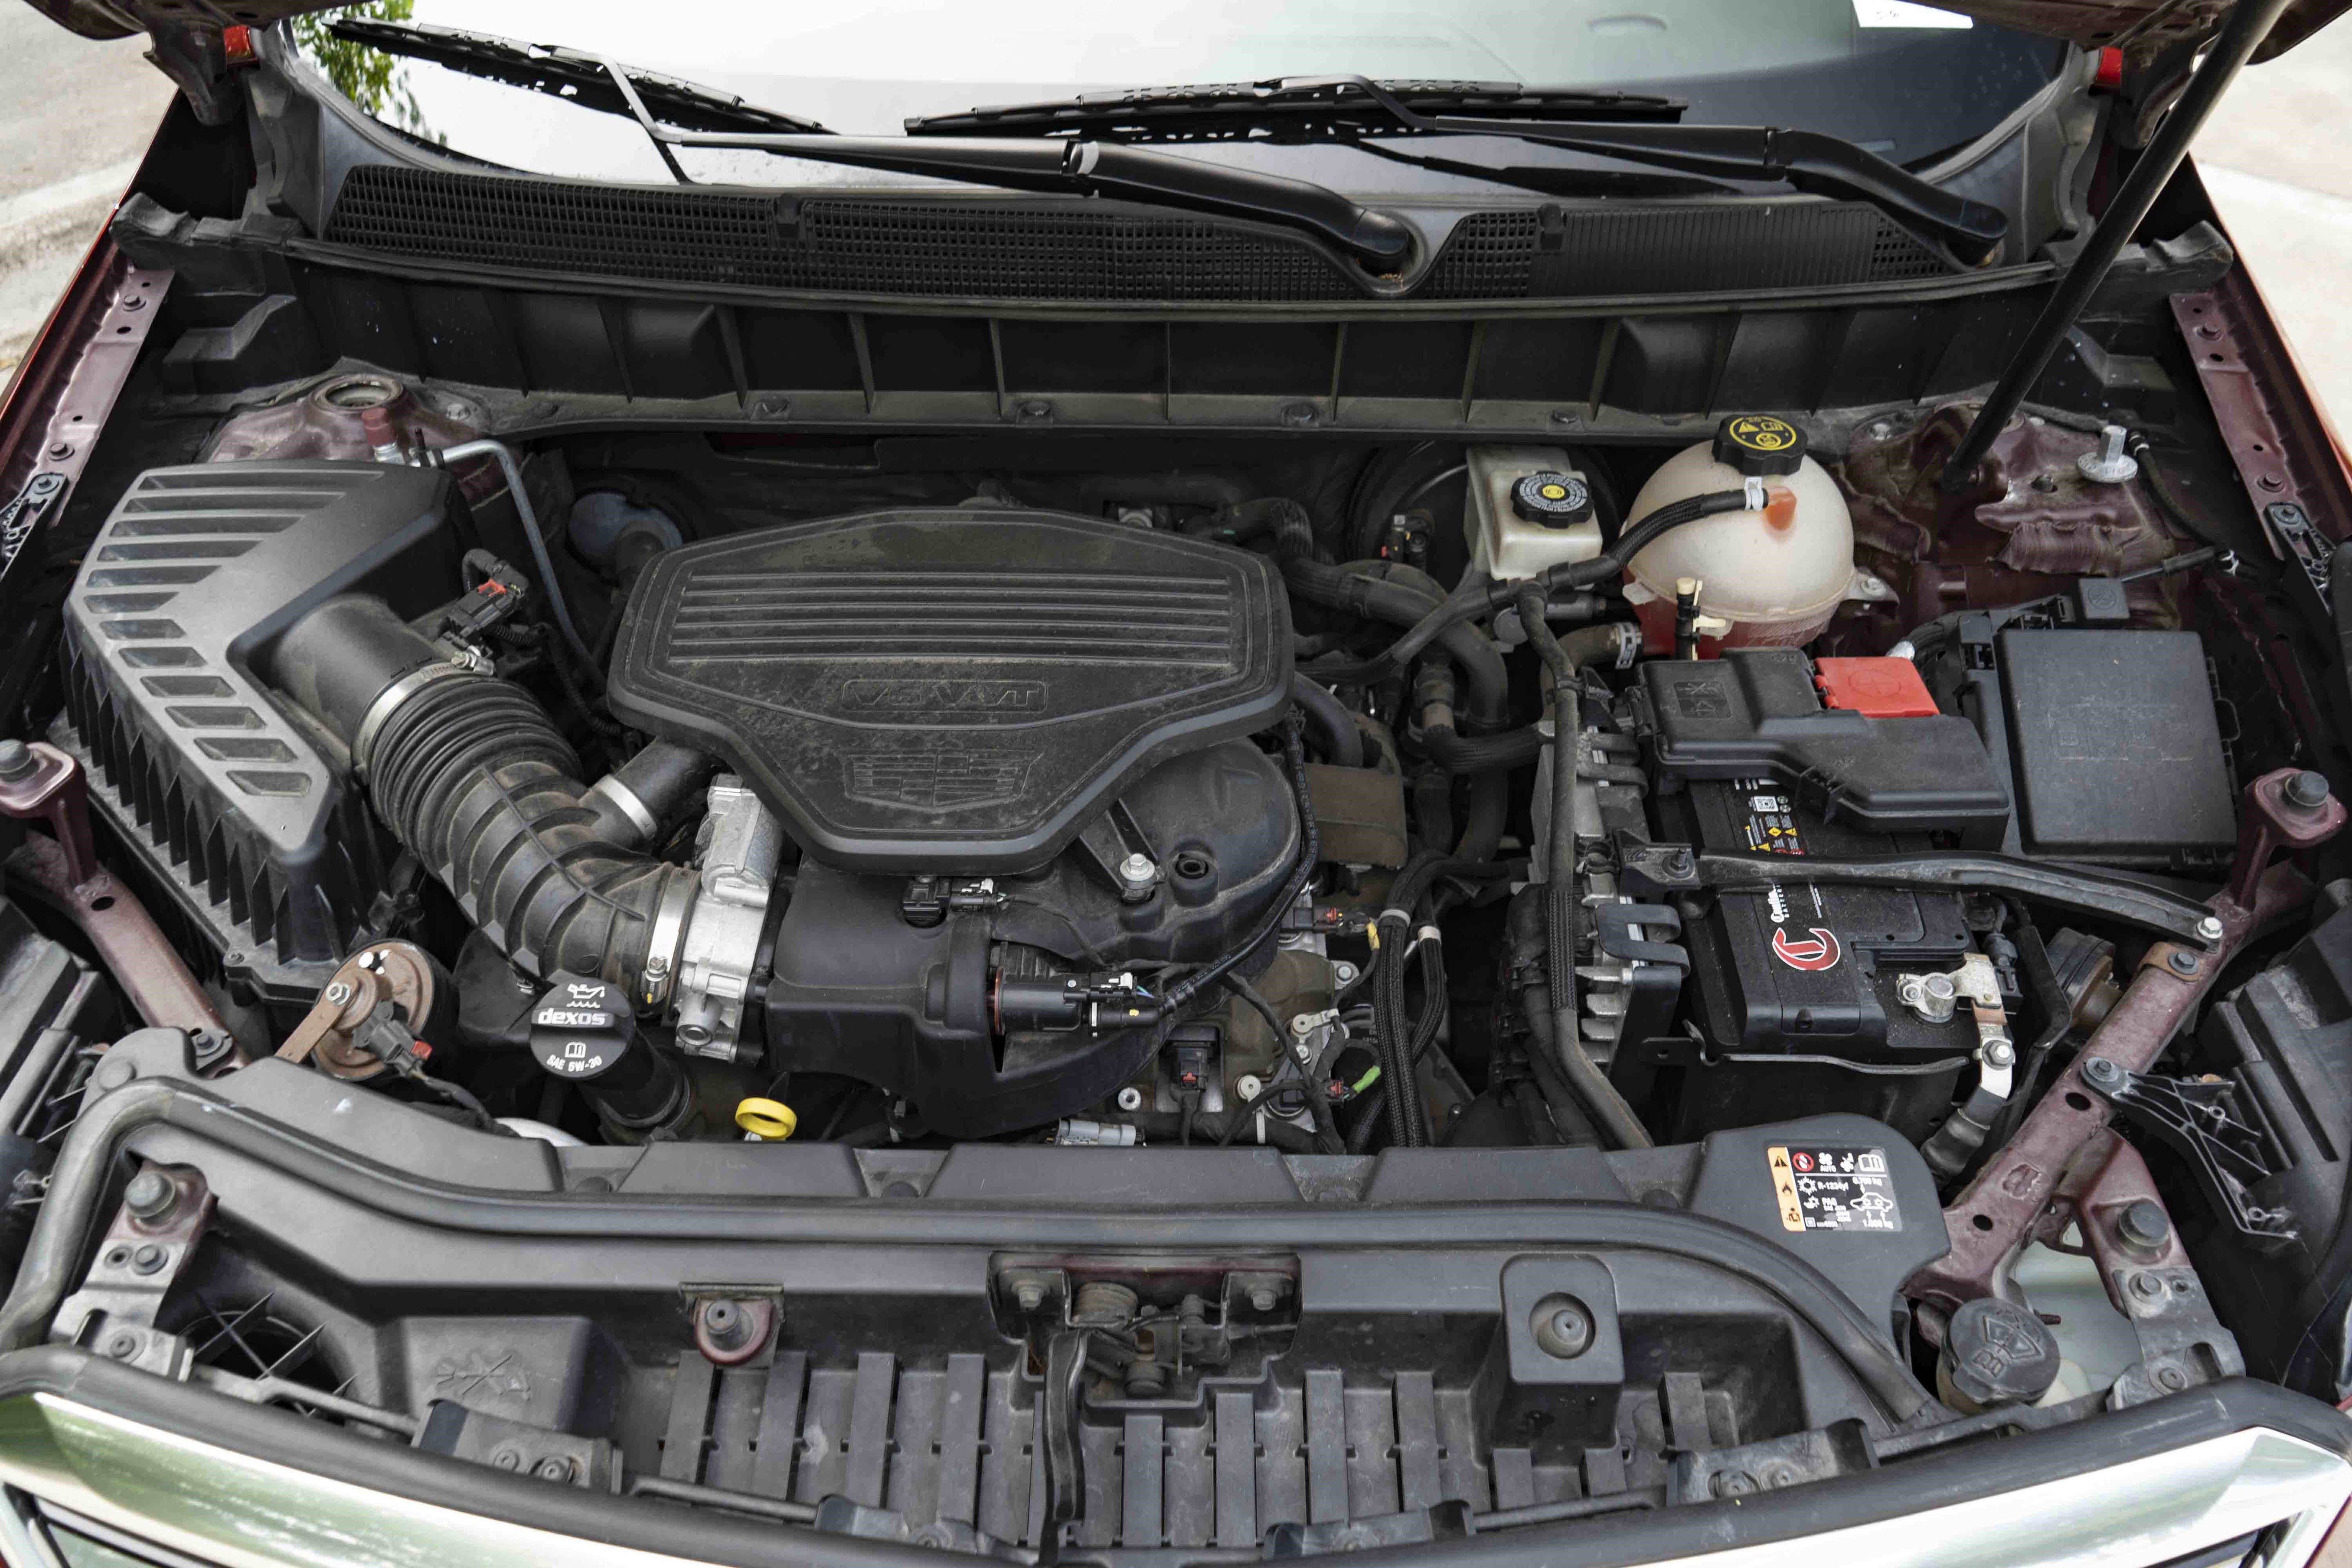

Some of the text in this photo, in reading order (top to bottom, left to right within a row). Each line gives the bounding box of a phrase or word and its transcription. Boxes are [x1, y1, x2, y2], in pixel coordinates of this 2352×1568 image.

[538, 1007, 606, 1025] dexos
[546, 1054, 602, 1072] SAE 5W-30
